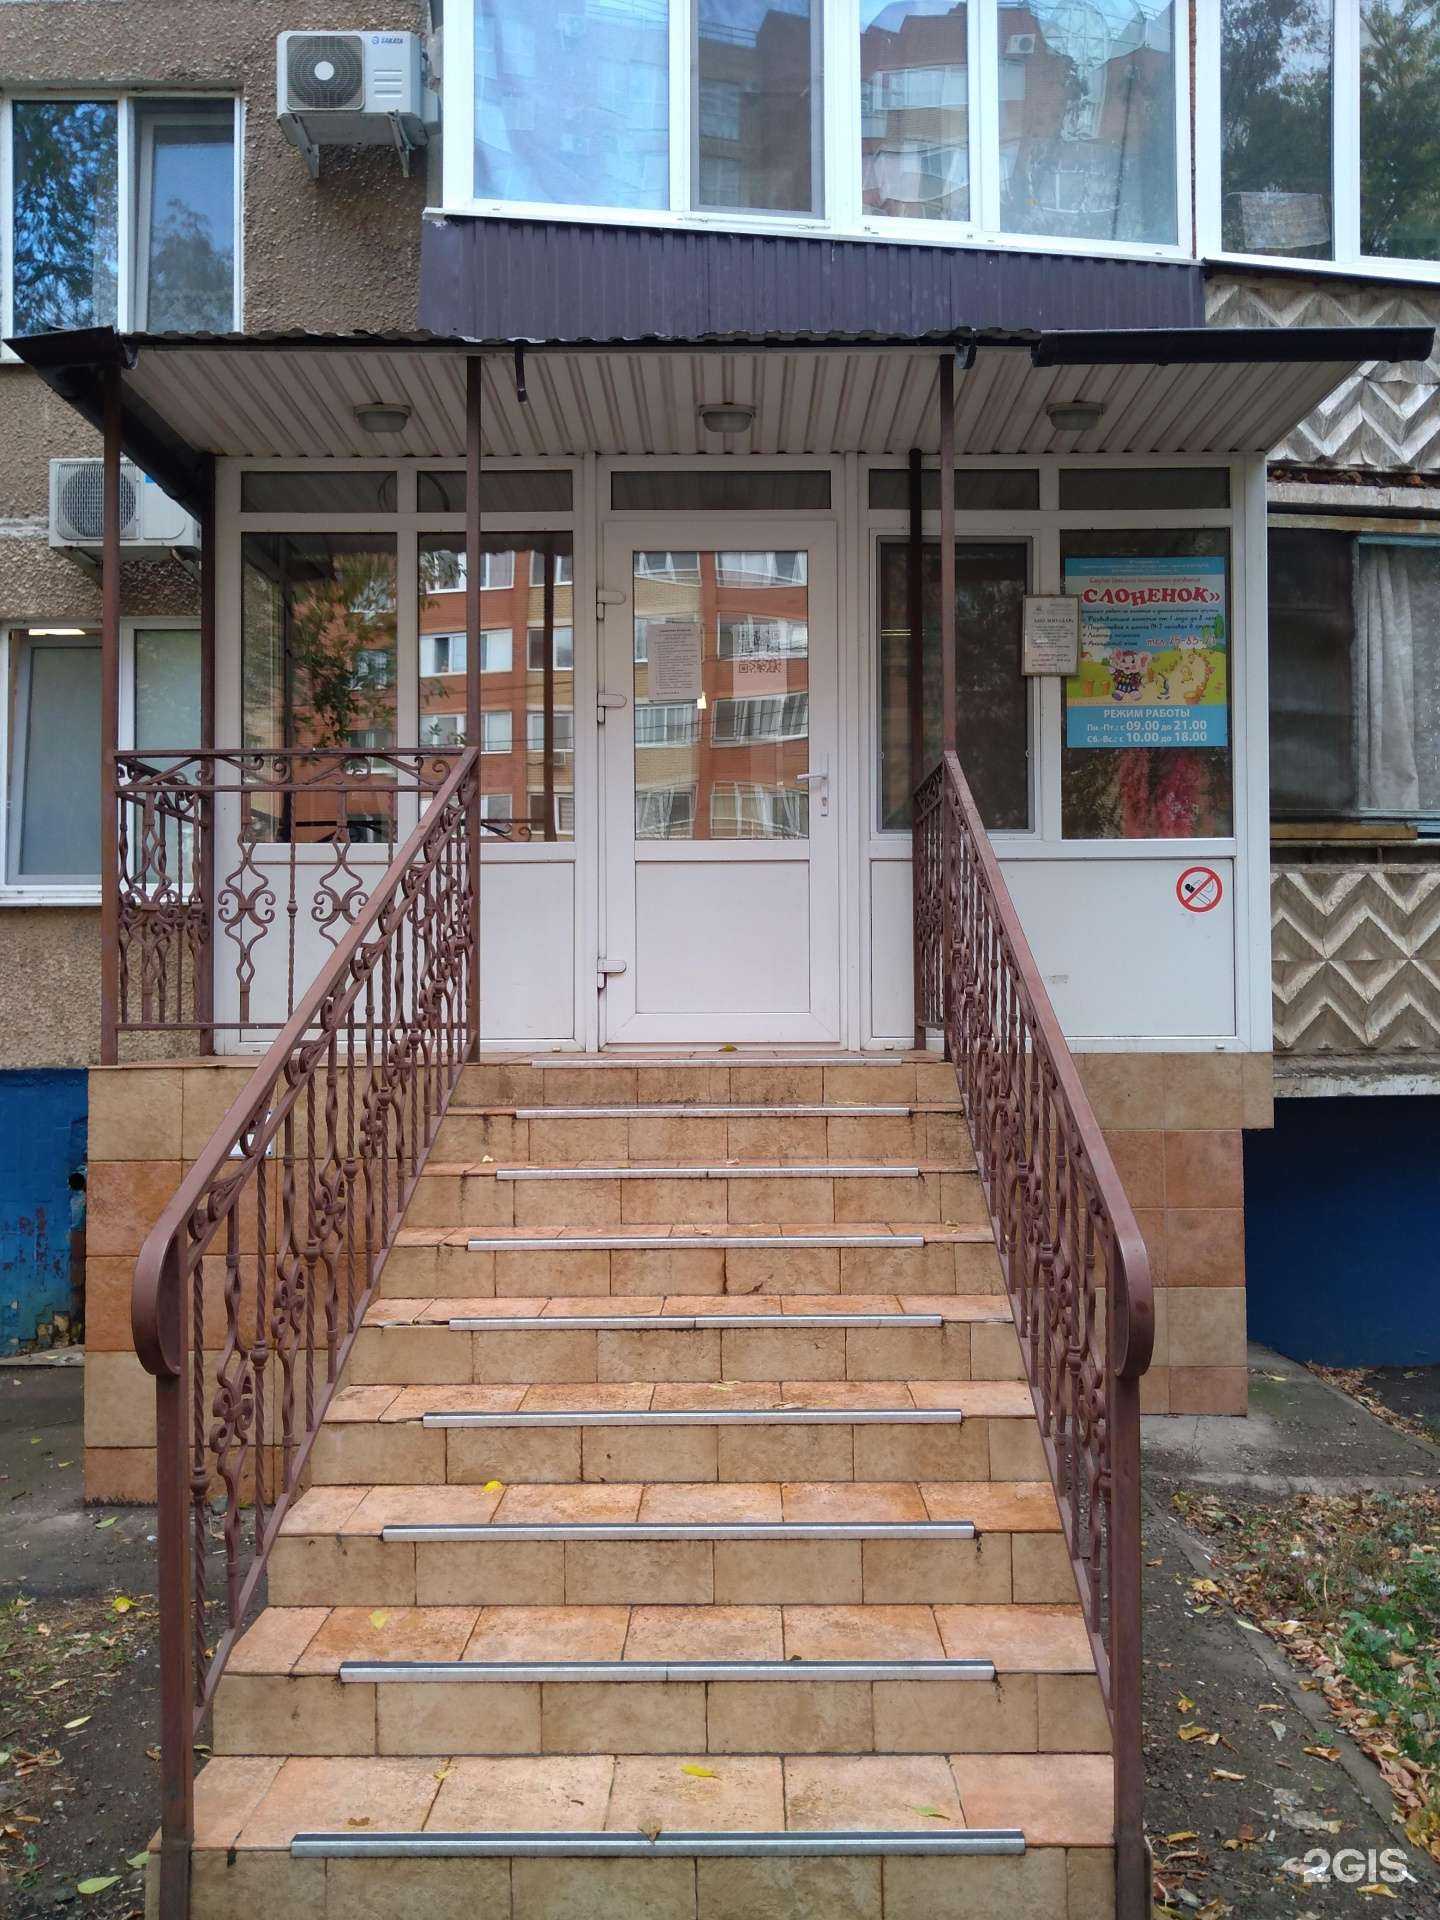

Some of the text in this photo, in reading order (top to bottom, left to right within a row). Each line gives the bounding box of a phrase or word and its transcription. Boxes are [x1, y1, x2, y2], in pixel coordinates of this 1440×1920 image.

[1083, 587, 1220, 606] СЛОНЕНОК»
[1104, 708, 1190, 718] РЕЖИМ РАБОТЫ
[1126, 720, 1159, 731] 09.00
[1174, 720, 1207, 730] 21.00
[1127, 732, 1159, 742] 10.00
[1175, 732, 1207, 742] 18.00
